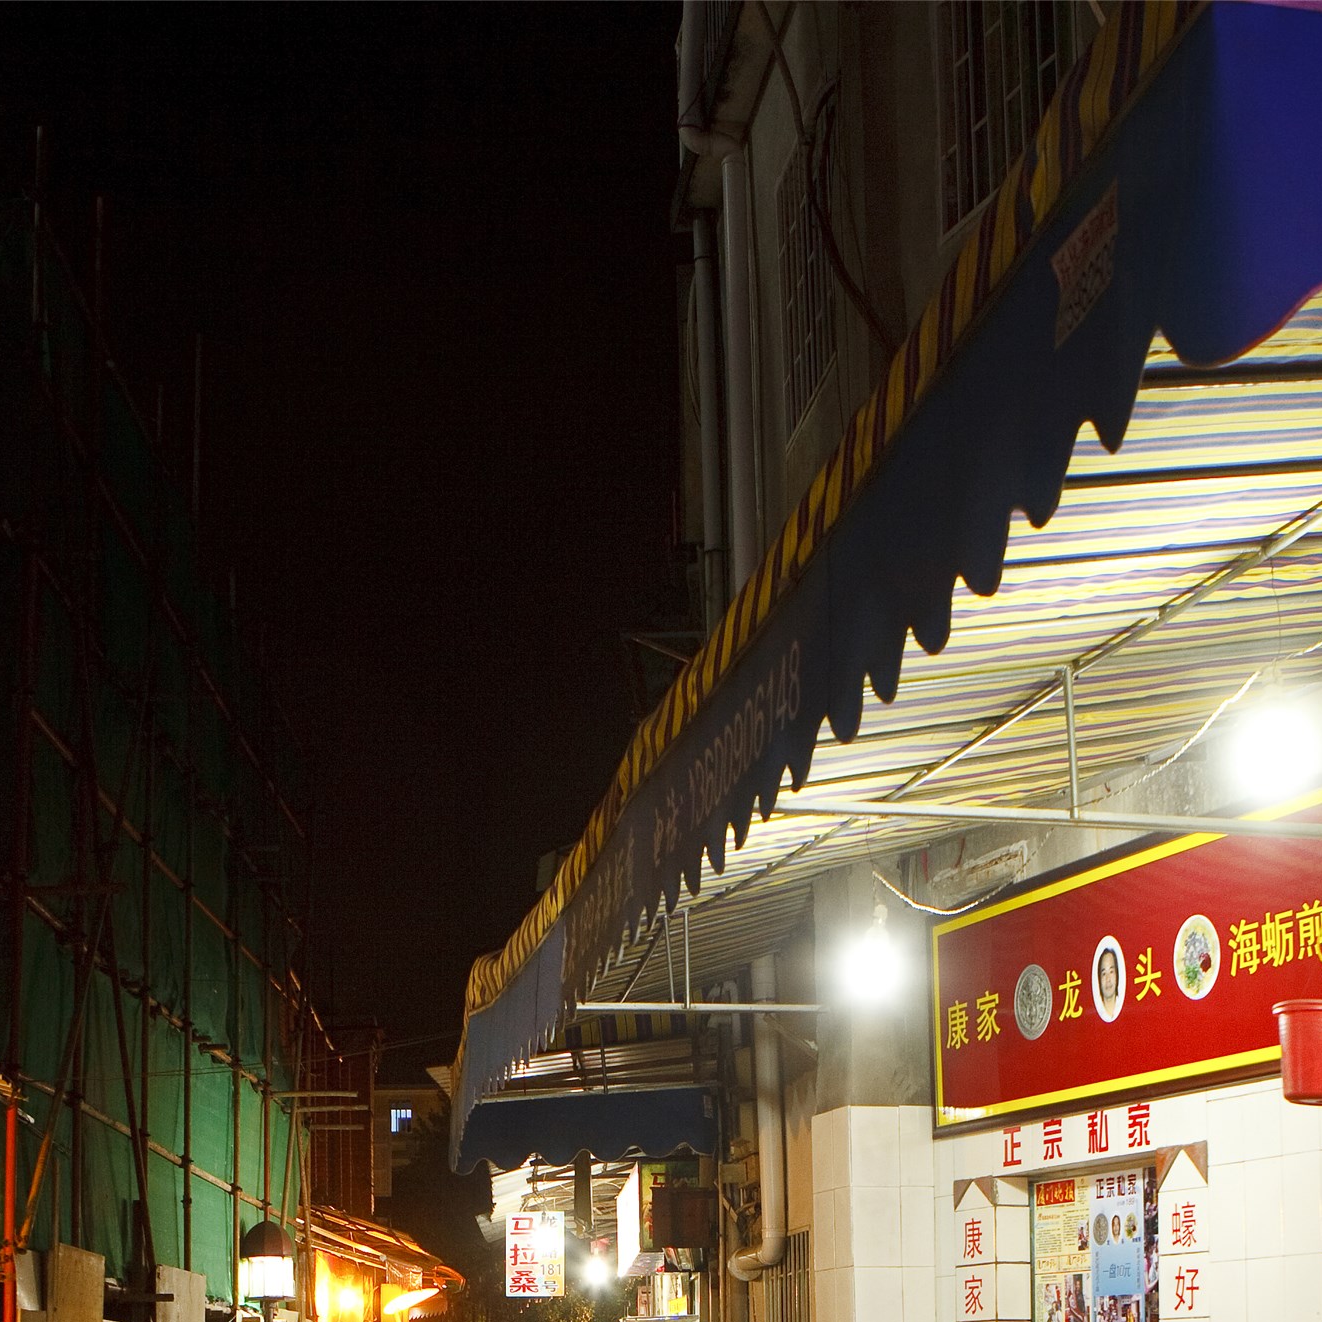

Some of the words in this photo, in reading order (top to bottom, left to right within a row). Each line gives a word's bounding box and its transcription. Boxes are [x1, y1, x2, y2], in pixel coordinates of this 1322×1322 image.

[946, 990, 1001, 1051] 康家
[1058, 970, 1084, 1022] 龙
[1133, 947, 1162, 1001] 头
[1002, 1103, 1153, 1168] 正宗私家
[1096, 1174, 1137, 1199] 正宗私家
[509, 1216, 539, 1293] 马拉桑
